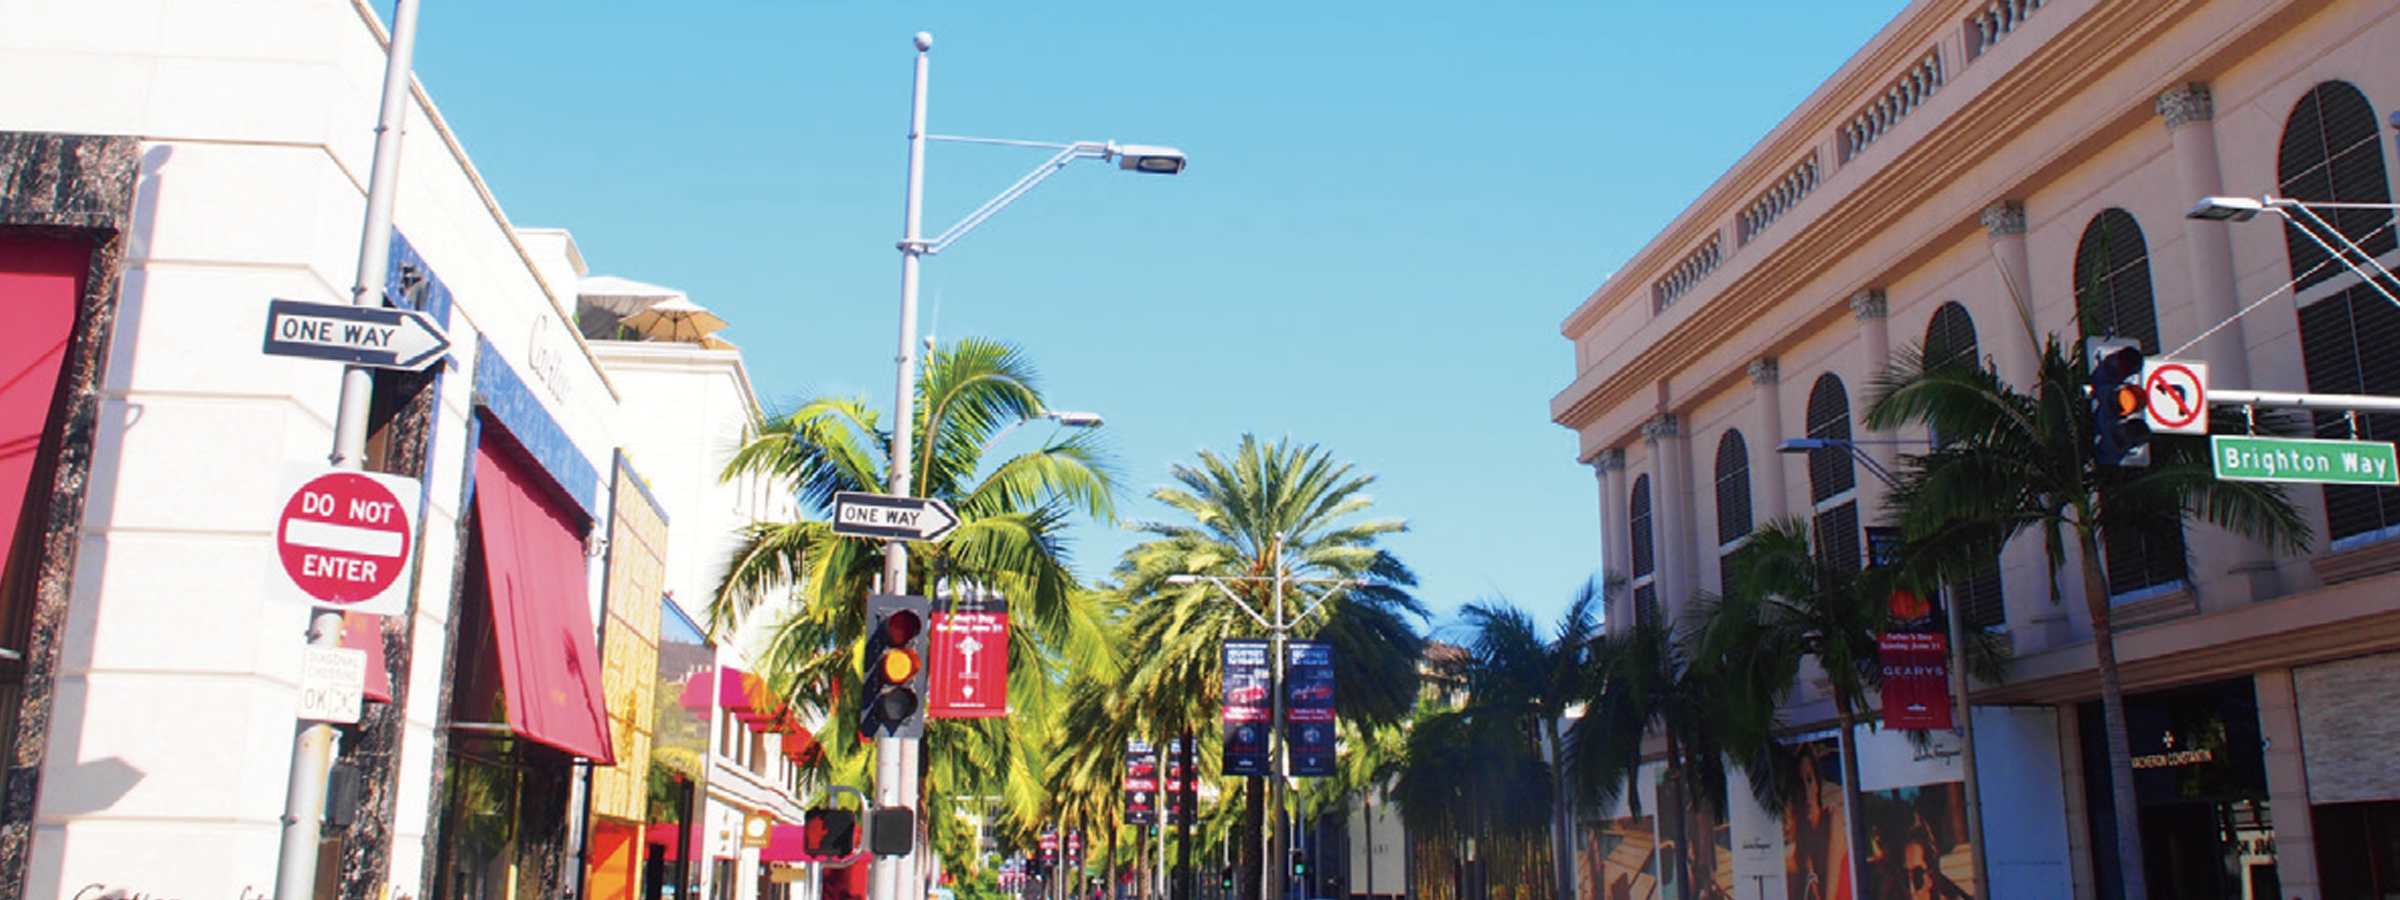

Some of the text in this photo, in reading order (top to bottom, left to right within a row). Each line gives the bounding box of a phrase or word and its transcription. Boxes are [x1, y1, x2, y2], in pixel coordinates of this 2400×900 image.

[282, 317, 396, 347] ONE WAY
[2225, 447, 2387, 479] Brighton Way
[302, 491, 395, 524] DO NOT
[845, 506, 921, 527] ONE WAY
[302, 554, 378, 583] ENTER
[1911, 642, 1930, 650] June
[1917, 633, 1933, 641] Day
[1882, 665, 1945, 677] GEARYS
[304, 688, 327, 711] OK
